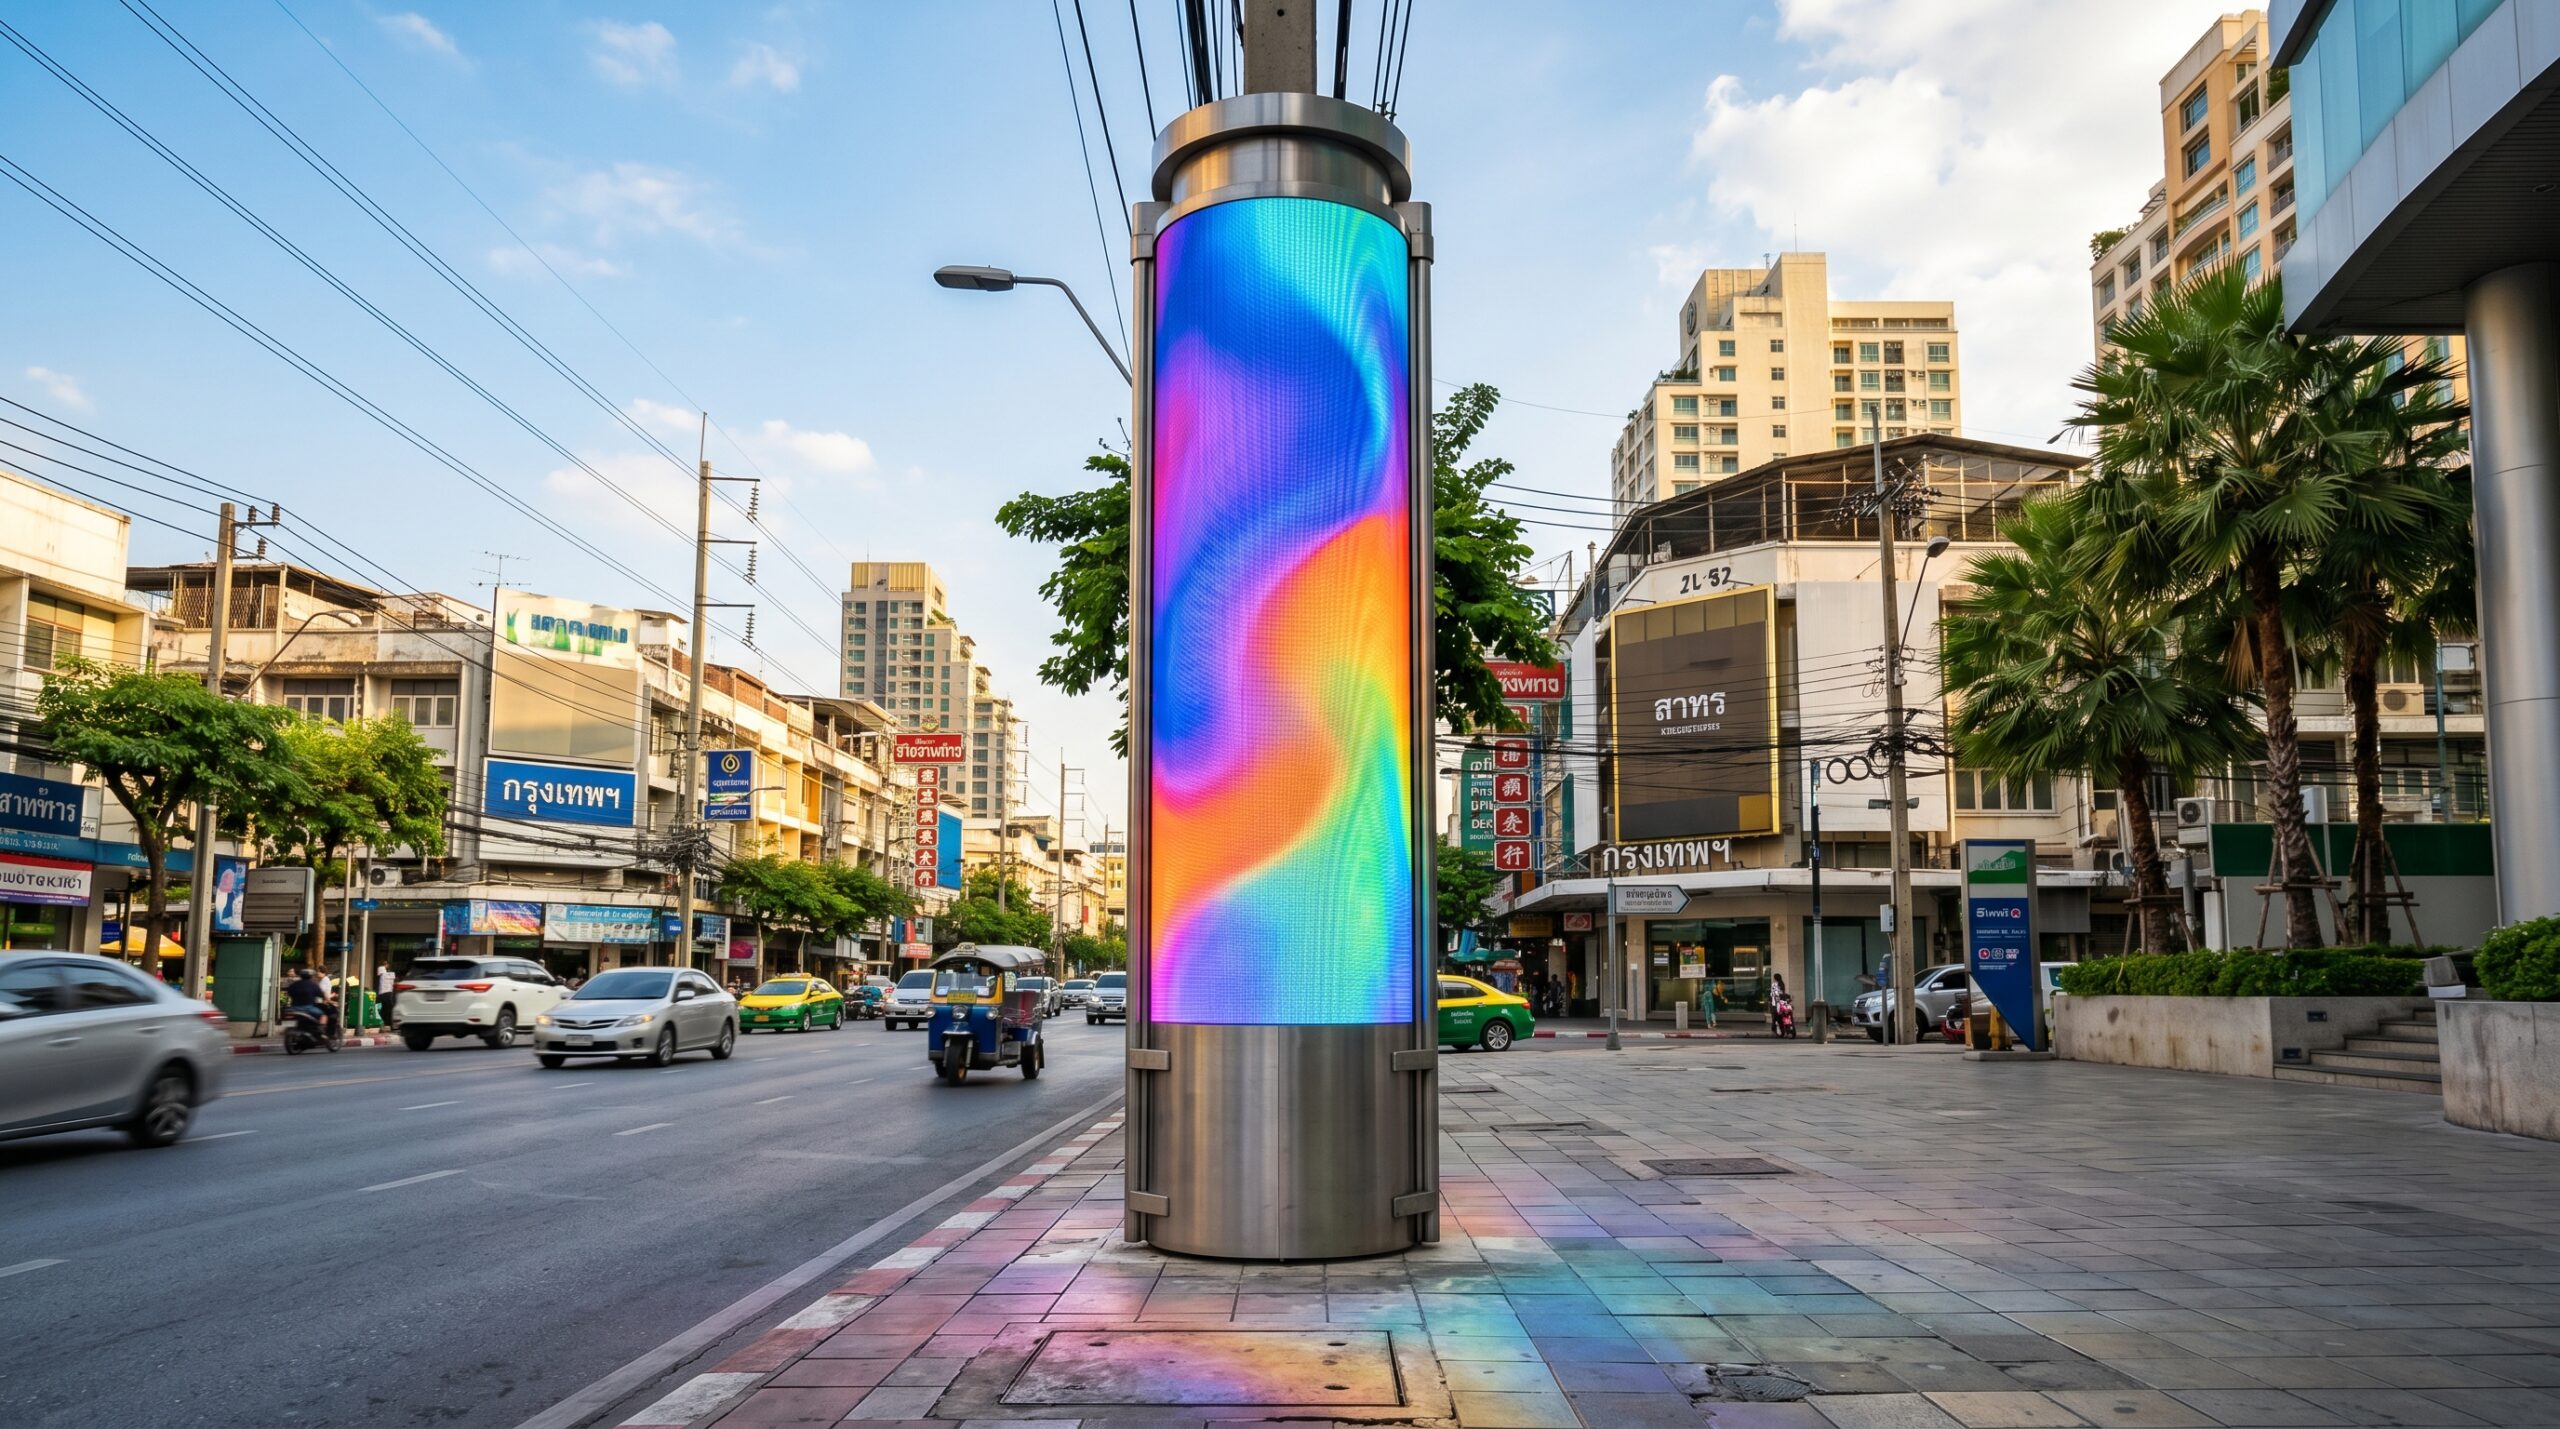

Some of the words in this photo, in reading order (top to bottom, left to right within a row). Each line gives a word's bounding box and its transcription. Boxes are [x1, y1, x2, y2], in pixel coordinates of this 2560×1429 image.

[1654, 691, 1726, 721] สาทร
[503, 779, 621, 815] กรุงเทพฯ
